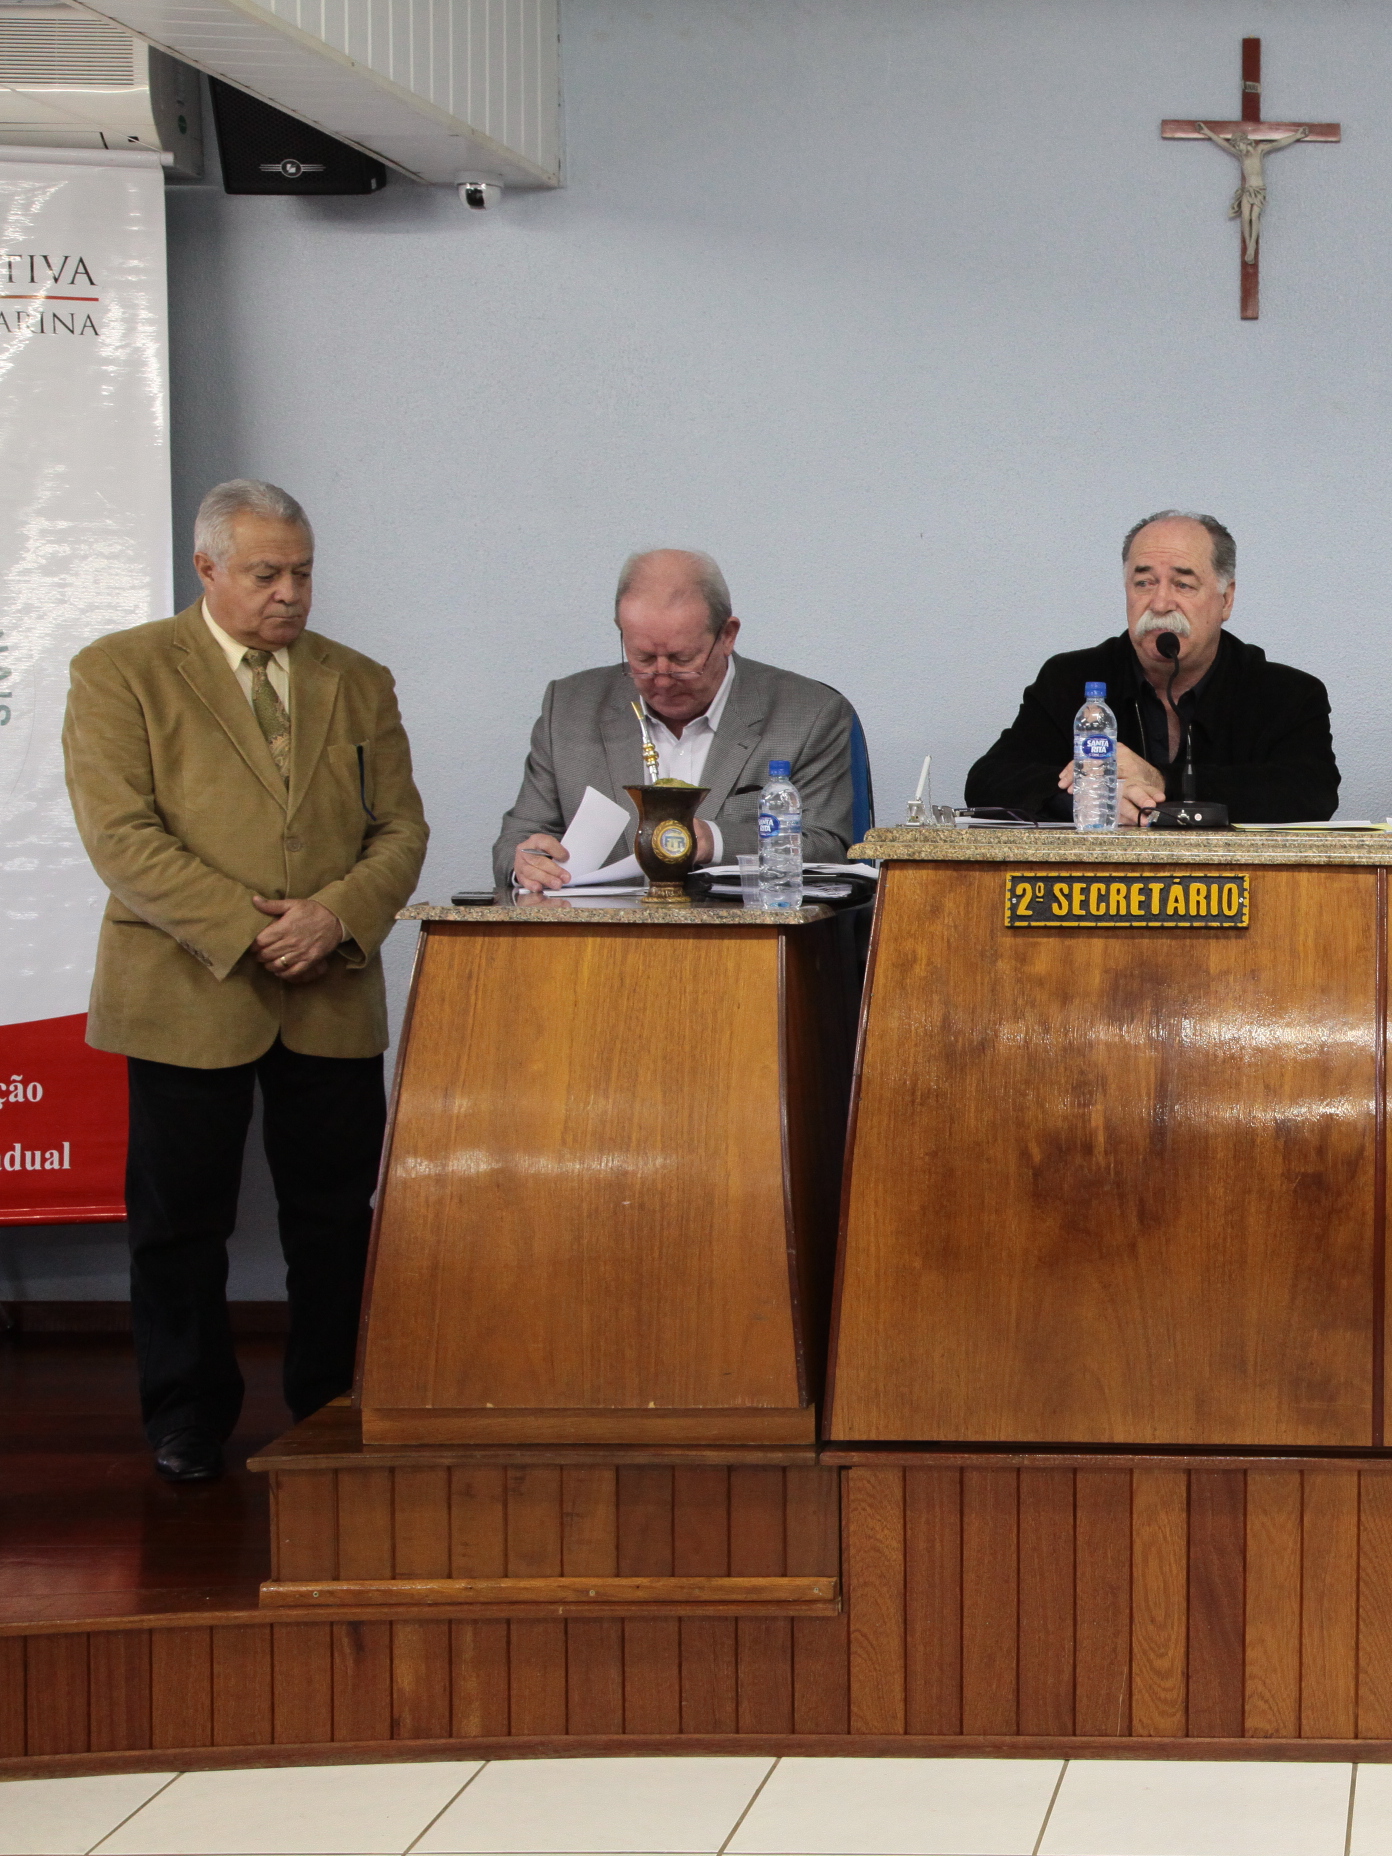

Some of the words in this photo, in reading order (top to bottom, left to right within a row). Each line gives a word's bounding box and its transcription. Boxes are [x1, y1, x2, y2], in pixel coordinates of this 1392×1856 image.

[1087, 739, 1109, 748] SANTA
[1091, 746, 1107, 754] RITA
[1052, 878, 1239, 917] SECRETÁRIO
[0, 1142, 71, 1171] dual
